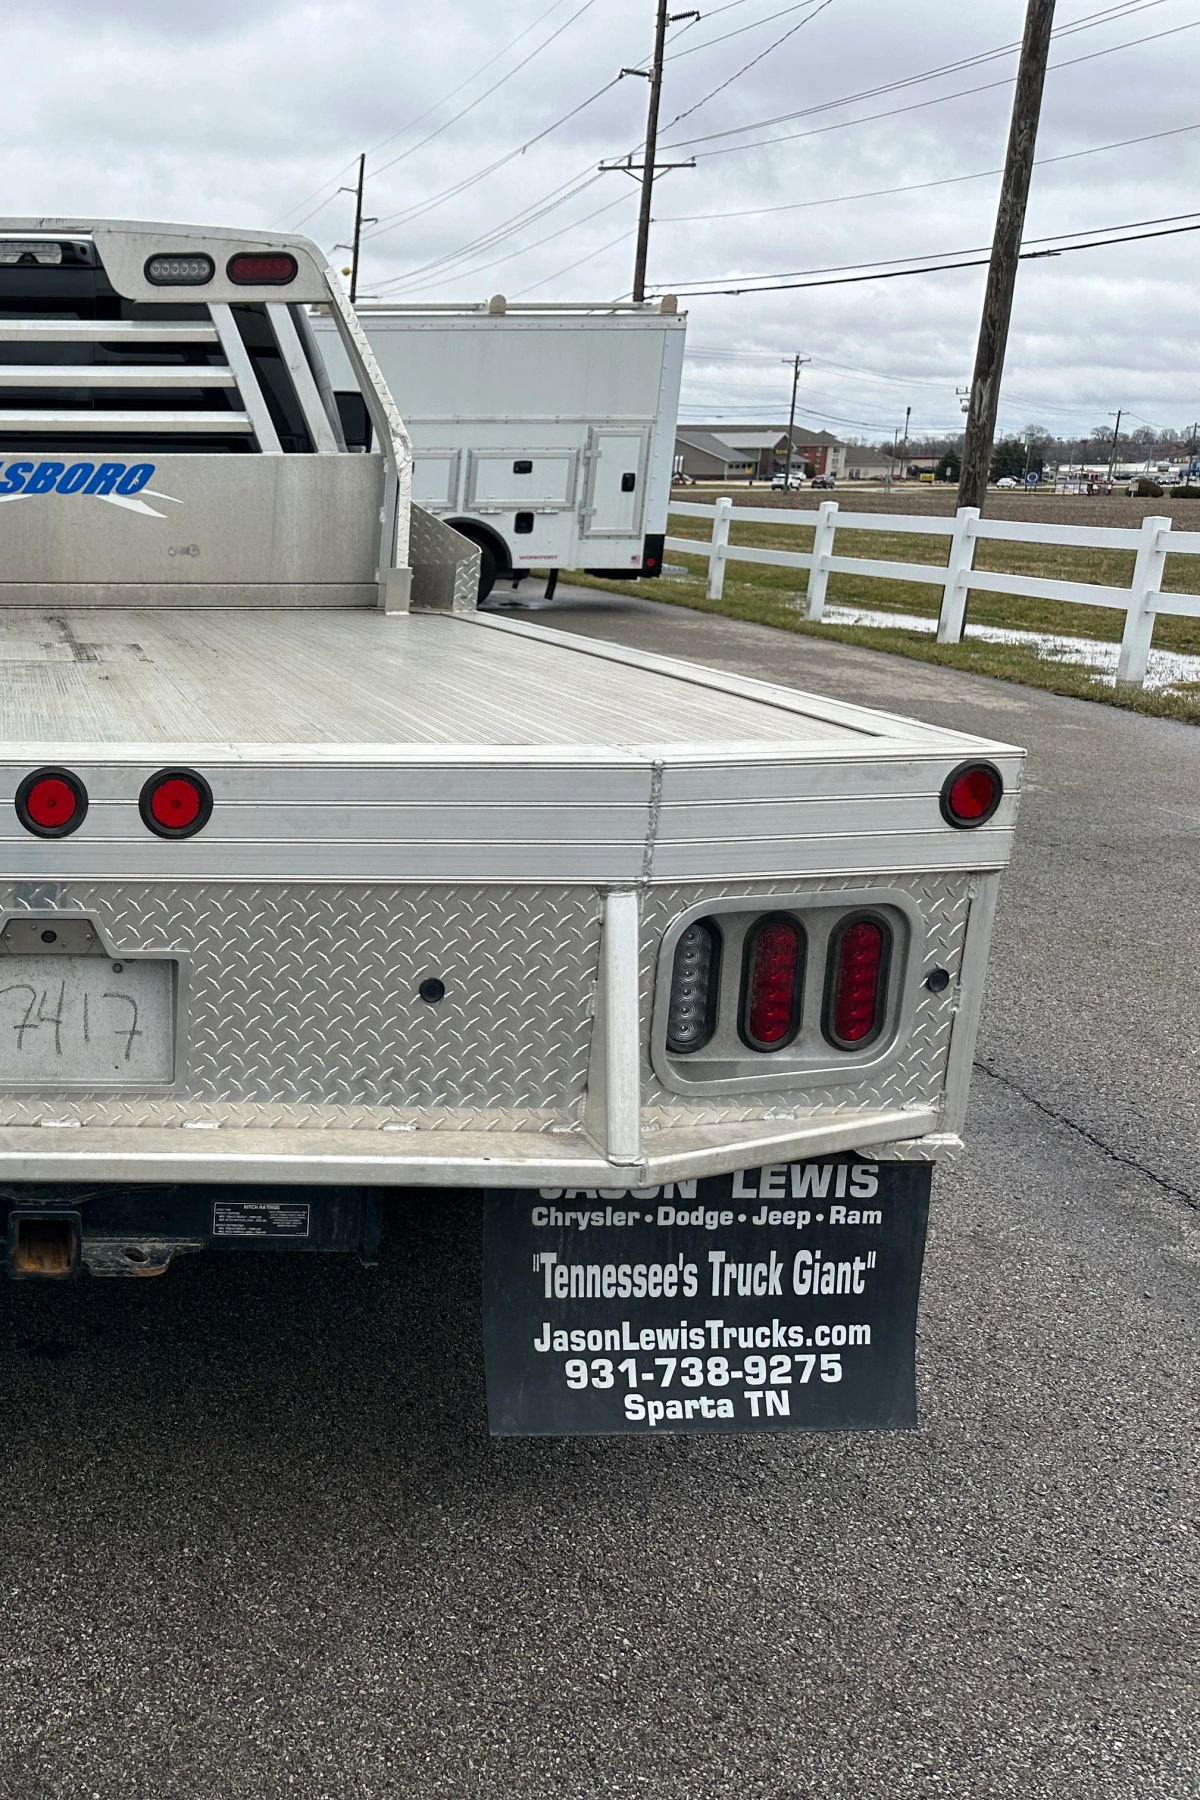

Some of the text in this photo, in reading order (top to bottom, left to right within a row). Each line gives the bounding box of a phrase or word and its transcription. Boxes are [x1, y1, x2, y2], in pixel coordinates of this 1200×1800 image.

[731, 1164, 879, 1199] LEWIS
[532, 1206, 882, 1230] Chrysler Dodge Jeep Ram
[533, 1250, 876, 1298] "Tennessee's Truck Giant"
[534, 1319, 871, 1352] JasonLewisTrucks.com
[565, 1354, 842, 1389] 931-738-9275
[624, 1390, 790, 1426] Sparta TN
